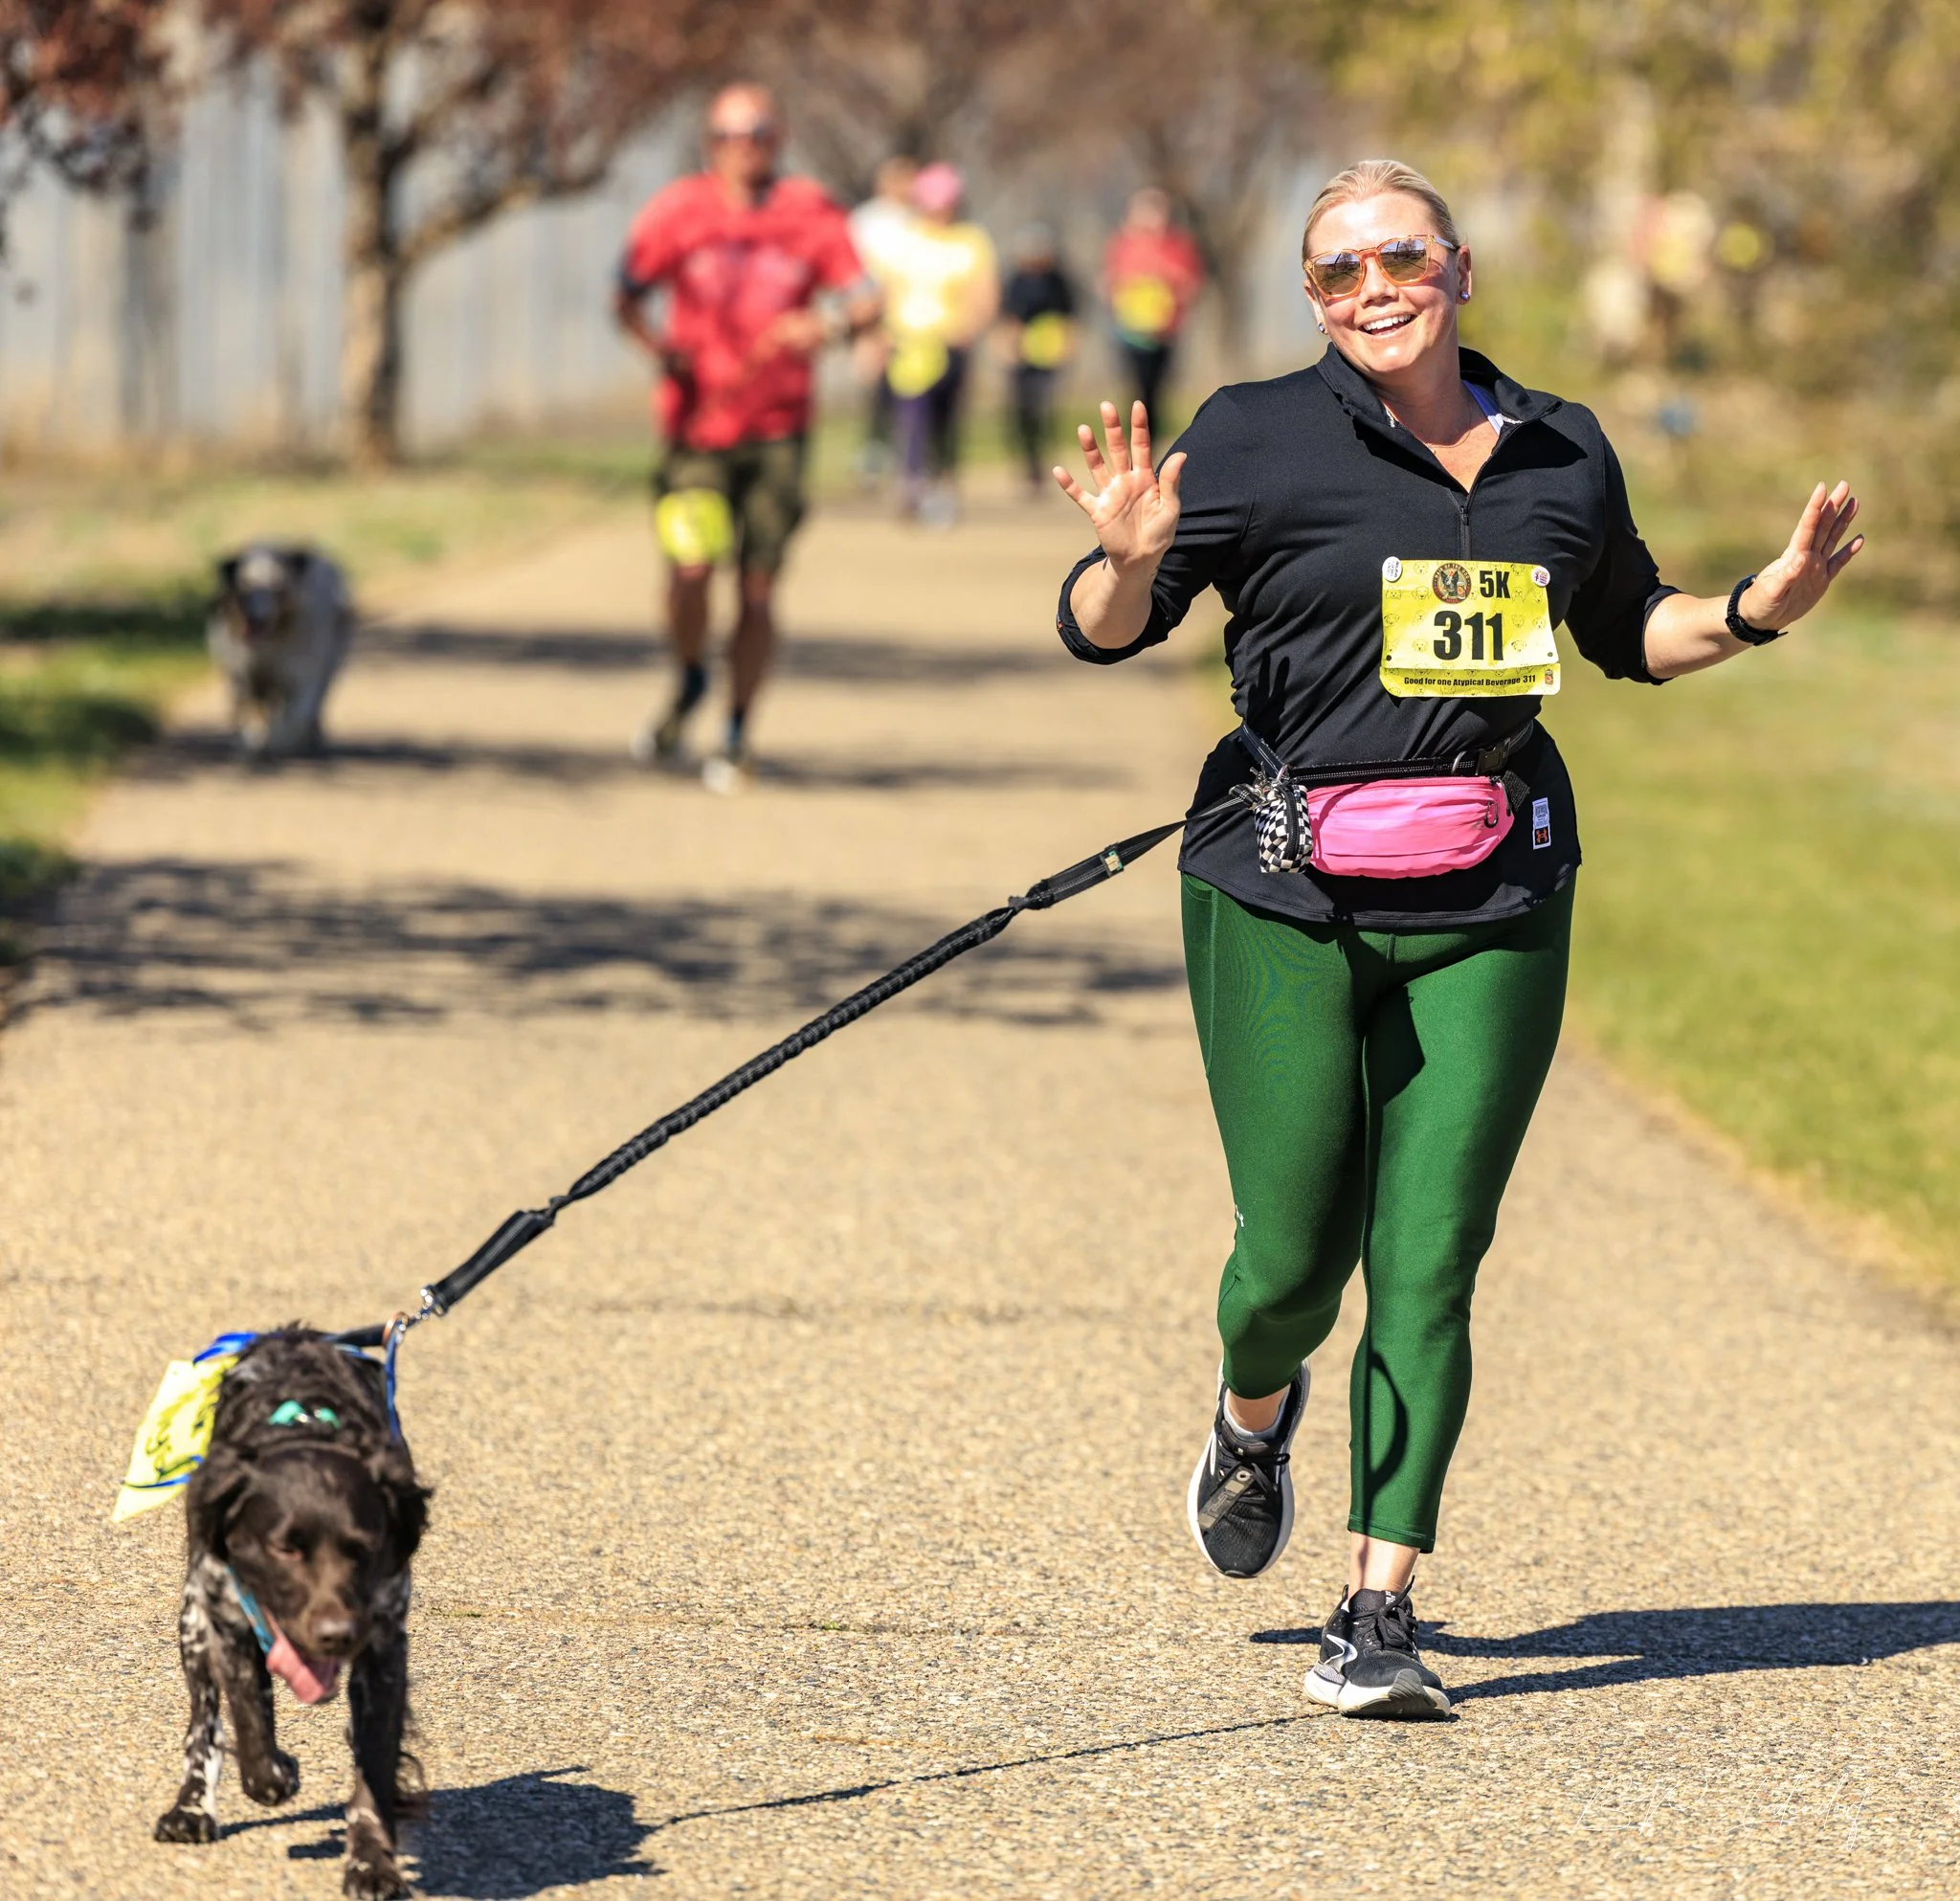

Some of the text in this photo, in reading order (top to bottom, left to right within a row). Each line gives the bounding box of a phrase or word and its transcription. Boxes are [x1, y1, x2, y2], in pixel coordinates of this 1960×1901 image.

[1480, 570, 1511, 599] 5K
[1433, 610, 1504, 660] 311
[1404, 677, 1424, 685] Good
[1453, 679, 1484, 687] Atypical
[1485, 677, 1521, 686] Beverage
[1523, 674, 1536, 683] 311
